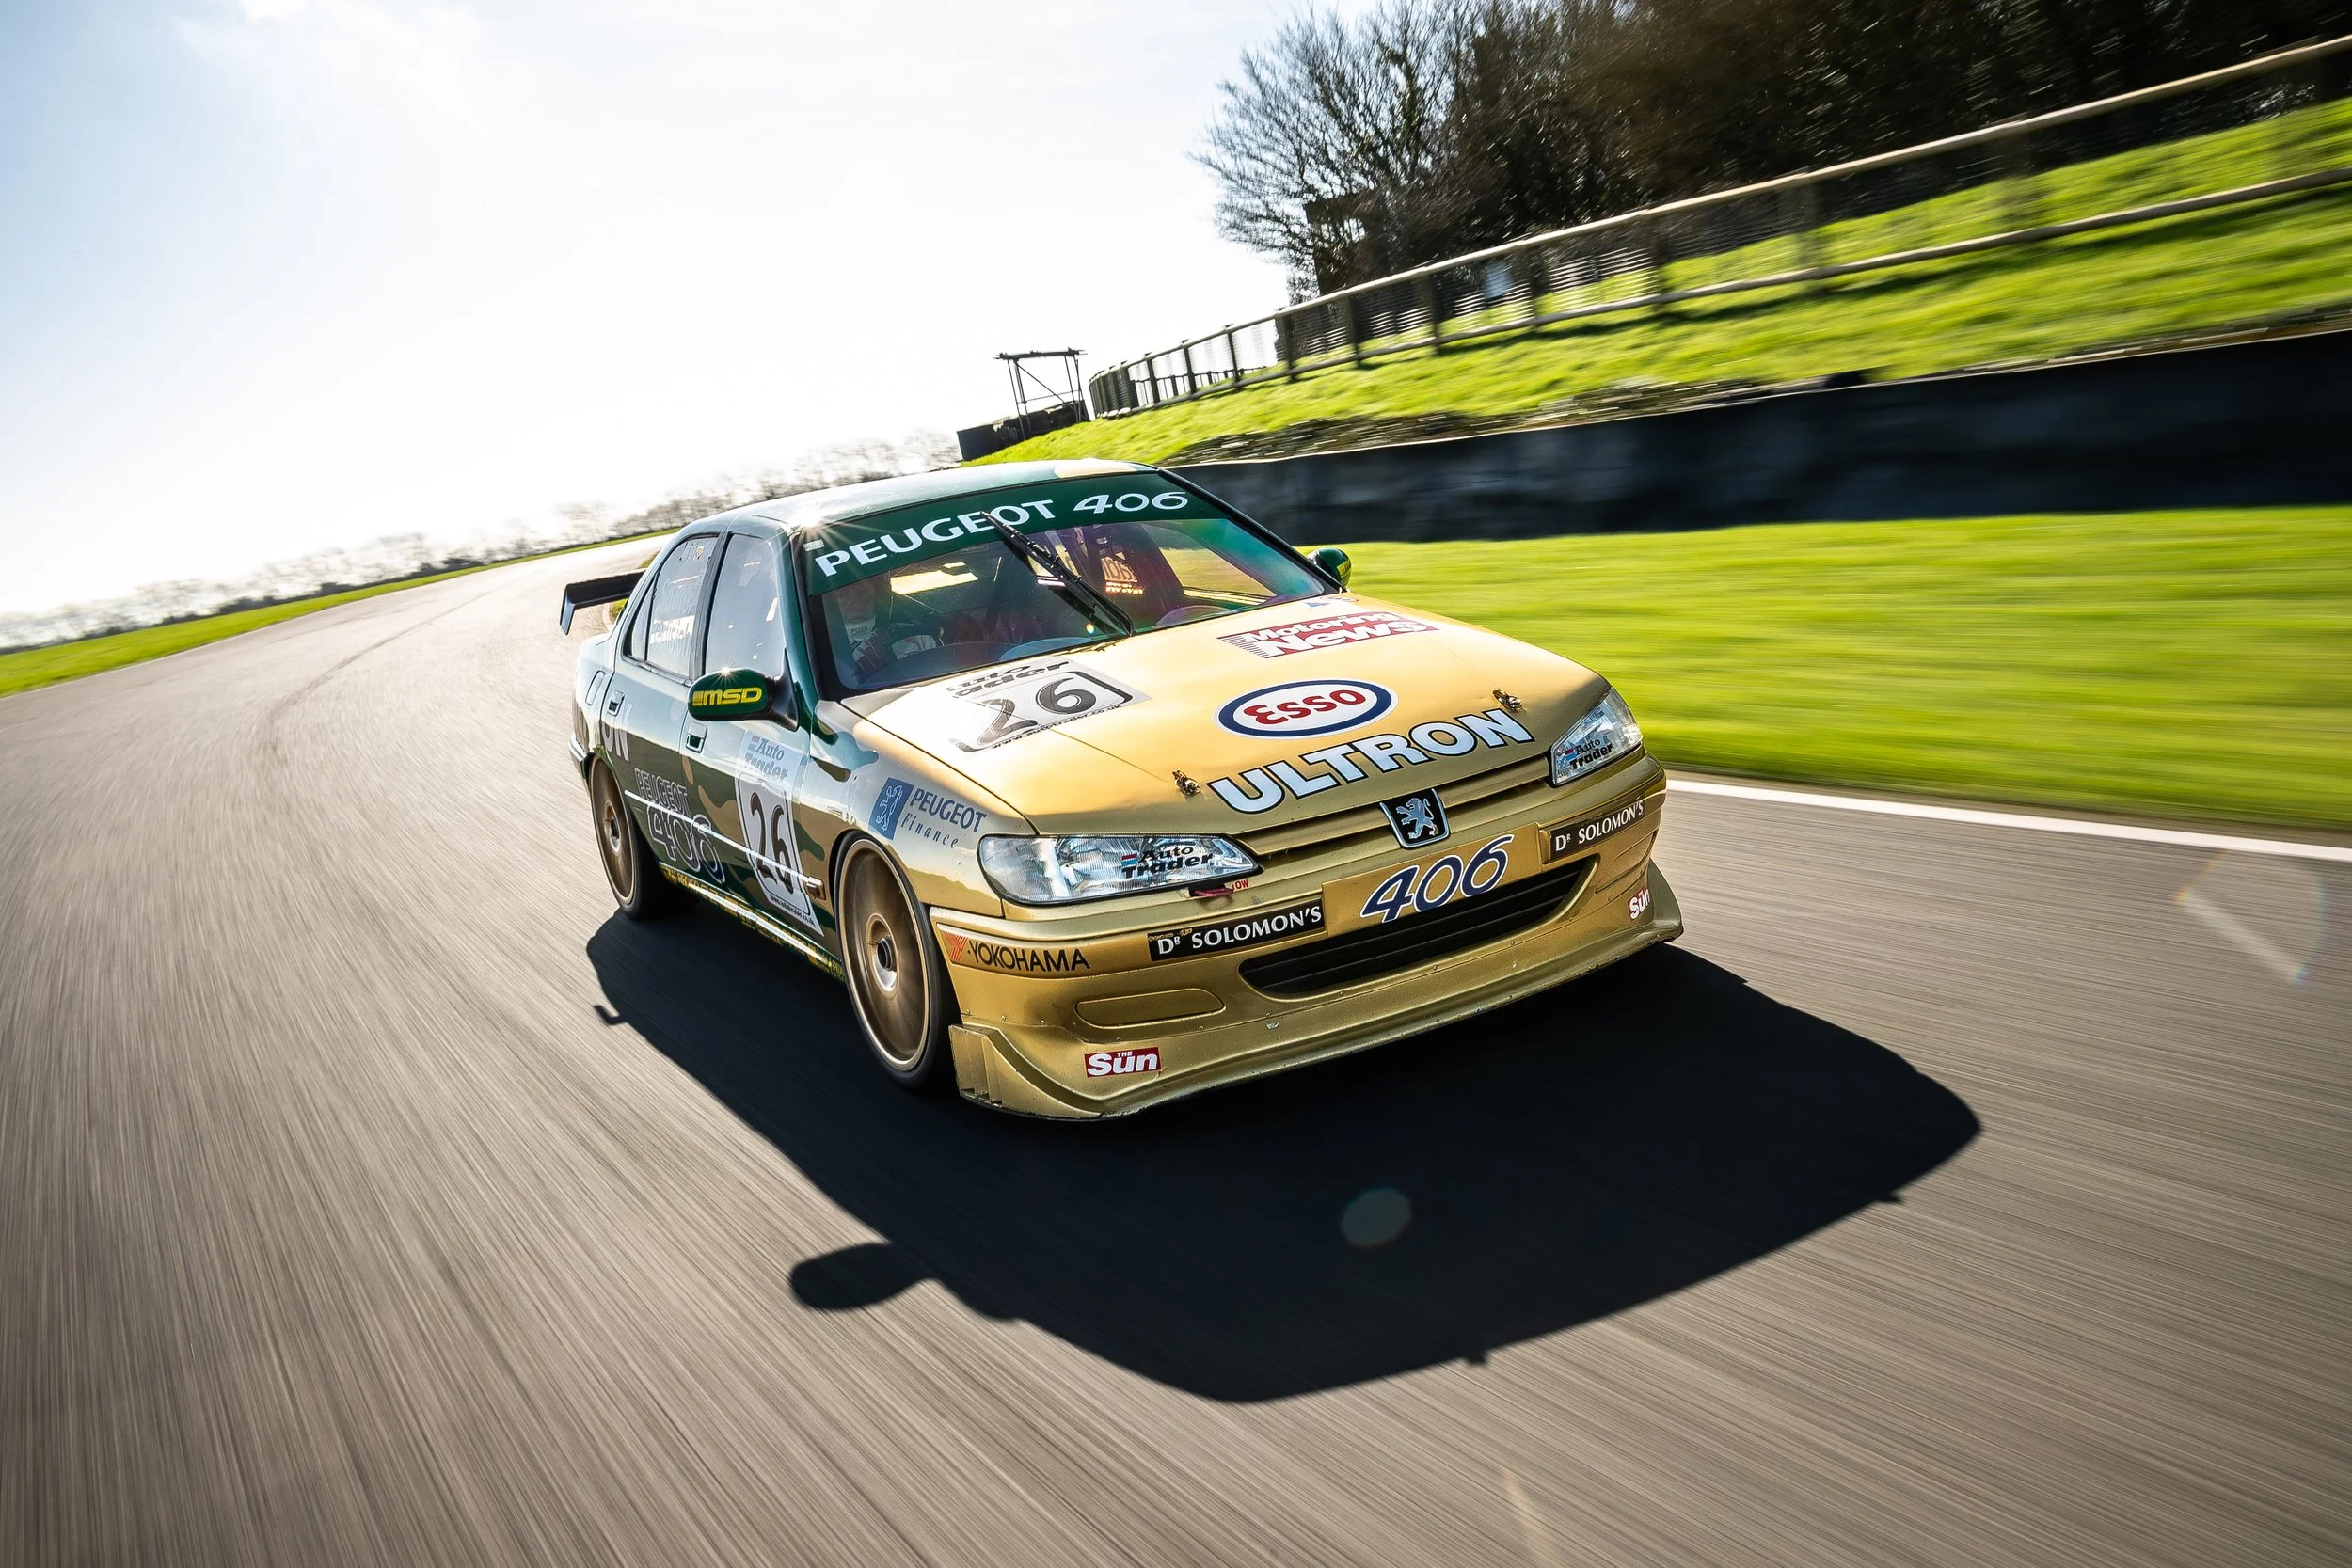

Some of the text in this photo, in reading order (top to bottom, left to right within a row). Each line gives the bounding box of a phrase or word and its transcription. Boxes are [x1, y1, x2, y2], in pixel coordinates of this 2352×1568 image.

[815, 499, 1055, 577] PEUGEOT
[1073, 491, 1189, 515] 406
[1244, 611, 1403, 641] Motoring
[1255, 621, 1429, 657] News
[976, 676, 1097, 746] 26
[755, 738, 786, 762] Auto
[1206, 708, 1535, 815] ULTRON
[1569, 742, 1613, 770] Trader
[1575, 738, 1601, 755] Auto
[634, 767, 691, 818] PEUGEOT
[910, 788, 987, 832] PEUGEOT
[900, 812, 959, 849] Finance
[1578, 800, 1645, 845] SOLOMON'S
[646, 813, 726, 884] 406
[750, 791, 794, 895] 26
[1138, 847, 1194, 863] Auto
[1120, 853, 1213, 879] Trader
[1359, 833, 1515, 924] 406
[1191, 906, 1322, 949] SOLOMON'S
[968, 941, 1091, 973] YOKOHAMA
[1087, 1052, 1159, 1076] Sun
